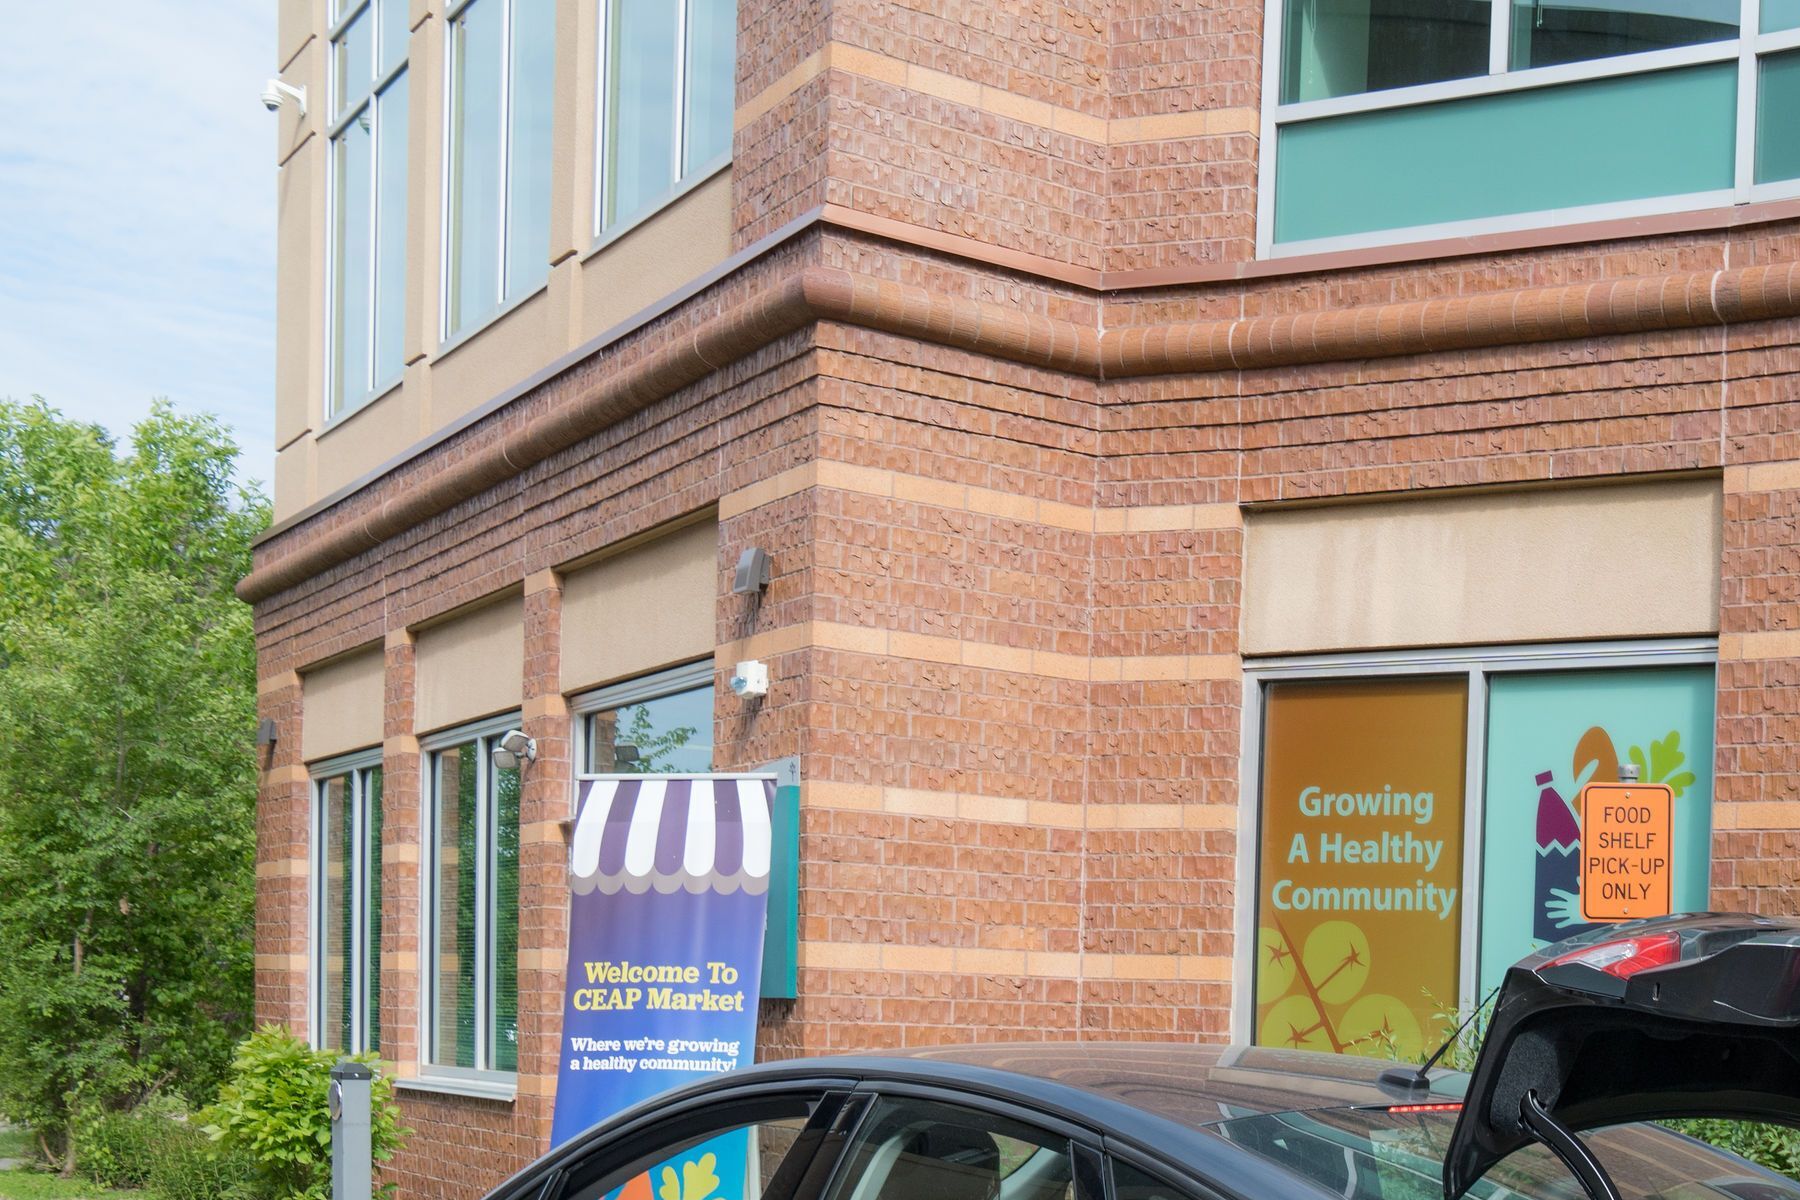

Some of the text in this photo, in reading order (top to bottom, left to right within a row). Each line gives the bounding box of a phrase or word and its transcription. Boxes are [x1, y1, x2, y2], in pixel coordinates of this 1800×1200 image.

[1299, 784, 1434, 824] Growing
[1604, 806, 1651, 823] FOOD
[1599, 832, 1656, 849] SHELF
[1288, 831, 1443, 872] A Healthy
[1589, 857, 1665, 875] PICK-UP
[1272, 879, 1457, 920] Community
[1602, 882, 1651, 900] ONLY
[584, 961, 739, 985] Welcome To
[573, 987, 745, 1012] CEAP Market
[570, 1036, 741, 1056] Where we're growing
[570, 1056, 737, 1073] a healthy community!
